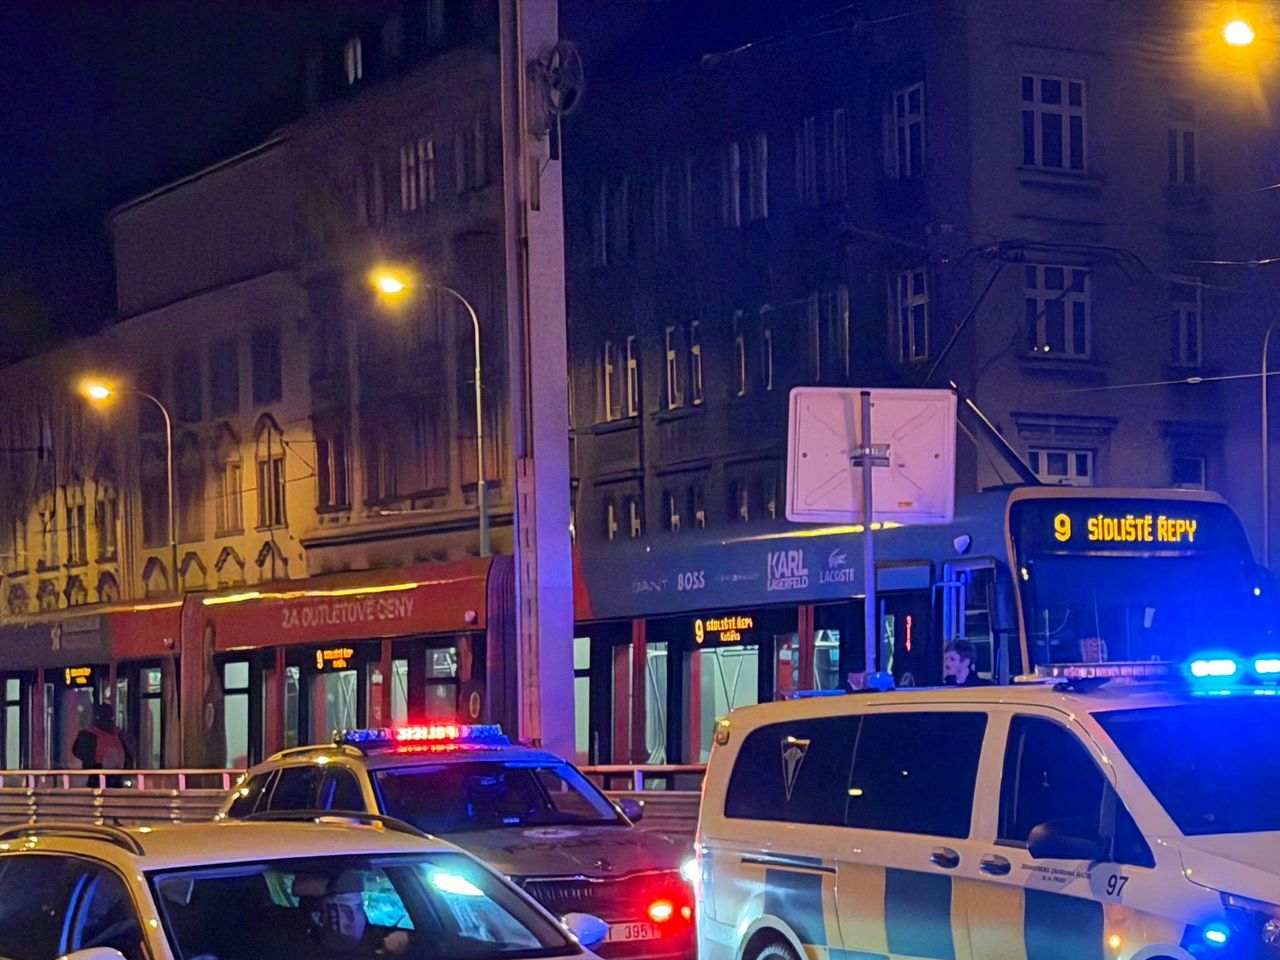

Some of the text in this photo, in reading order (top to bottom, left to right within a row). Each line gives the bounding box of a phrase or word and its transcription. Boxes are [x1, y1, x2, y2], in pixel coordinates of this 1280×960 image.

[1054, 513, 1197, 542] 9 SÍDLIŠTĚ ŘEPY
[767, 549, 809, 578] KARL
[819, 567, 855, 584] LACOSTE
[677, 569, 706, 591] BOSS
[767, 576, 809, 591] LAGERFELD
[282, 607, 300, 629] ZA
[377, 596, 414, 619] CENY
[695, 619, 705, 644] 9
[1106, 874, 1129, 897] 97
